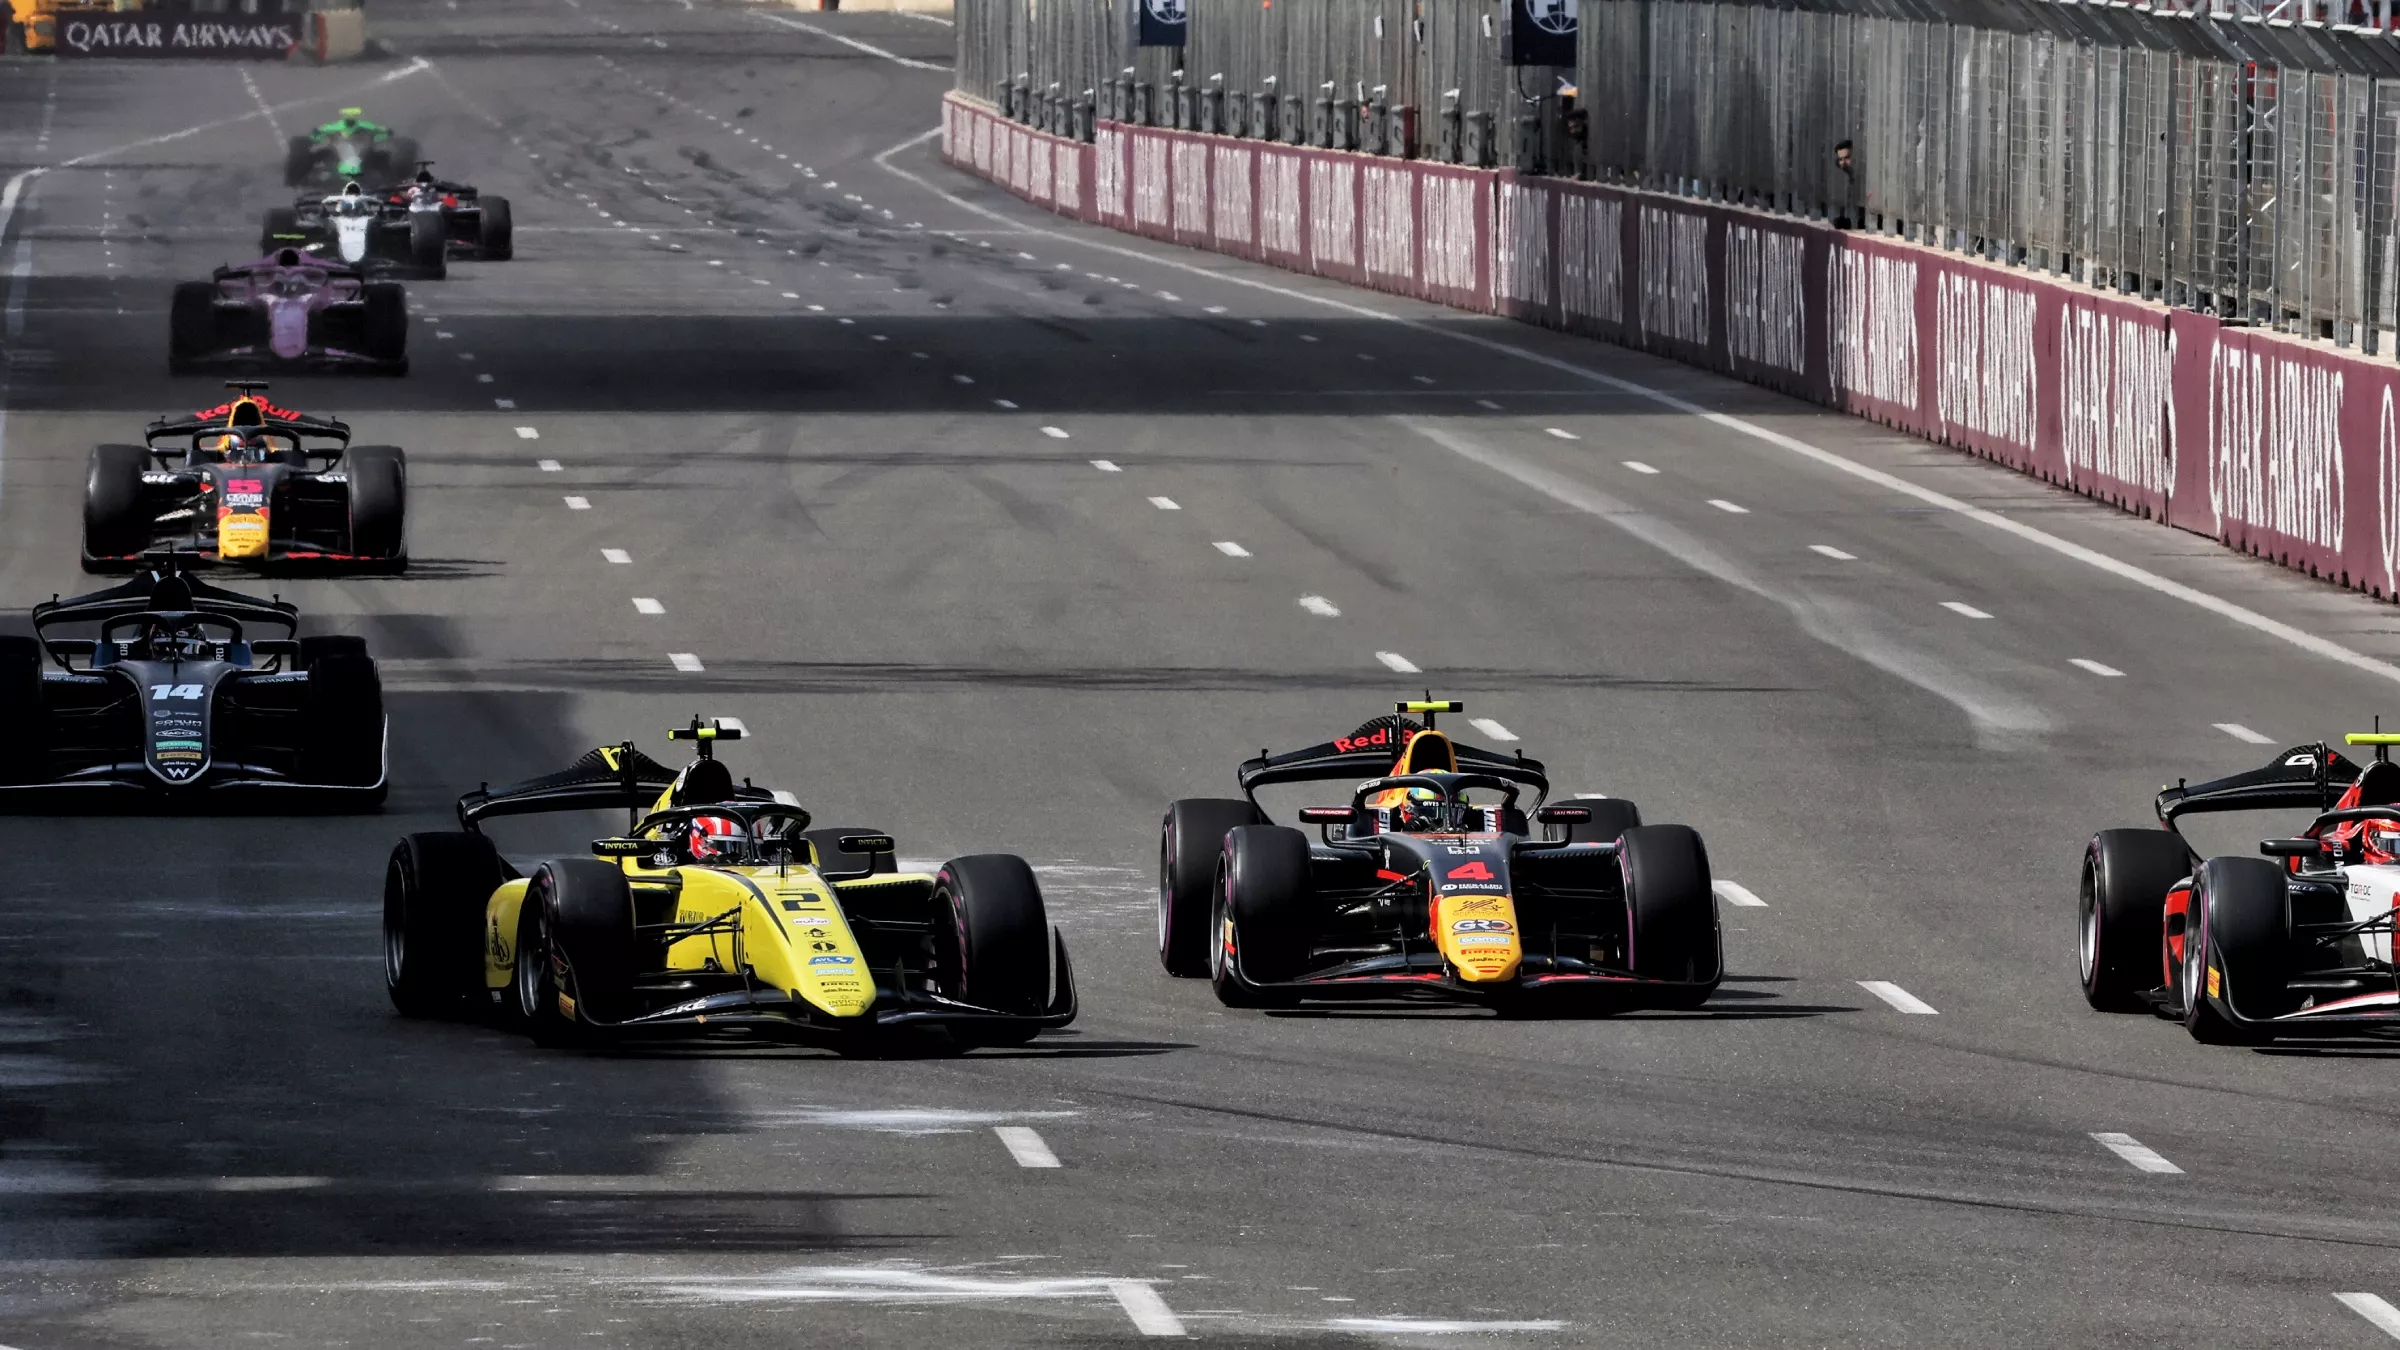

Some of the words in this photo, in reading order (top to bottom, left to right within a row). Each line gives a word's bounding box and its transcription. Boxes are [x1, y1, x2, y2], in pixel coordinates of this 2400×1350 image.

[66, 22, 162, 51] QATAR
[172, 23, 293, 49] AIRWAYS
[1827, 243, 1866, 401] QATAR
[1868, 252, 1918, 410] AIRWAYS
[1936, 269, 1980, 438] QATAR
[1982, 280, 2036, 451] AIRWAYS
[2060, 303, 2110, 482] QATAR
[2267, 355, 2344, 553] AIRWAYS
[227, 479, 263, 493] 5
[150, 684, 203, 700] 14
[1334, 728, 1388, 753] Red
[167, 767, 190, 778] W
[605, 842, 638, 850] INVICTA
[857, 838, 888, 846] INVICTA
[1447, 861, 1495, 880] 4
[777, 893, 825, 911] 2
